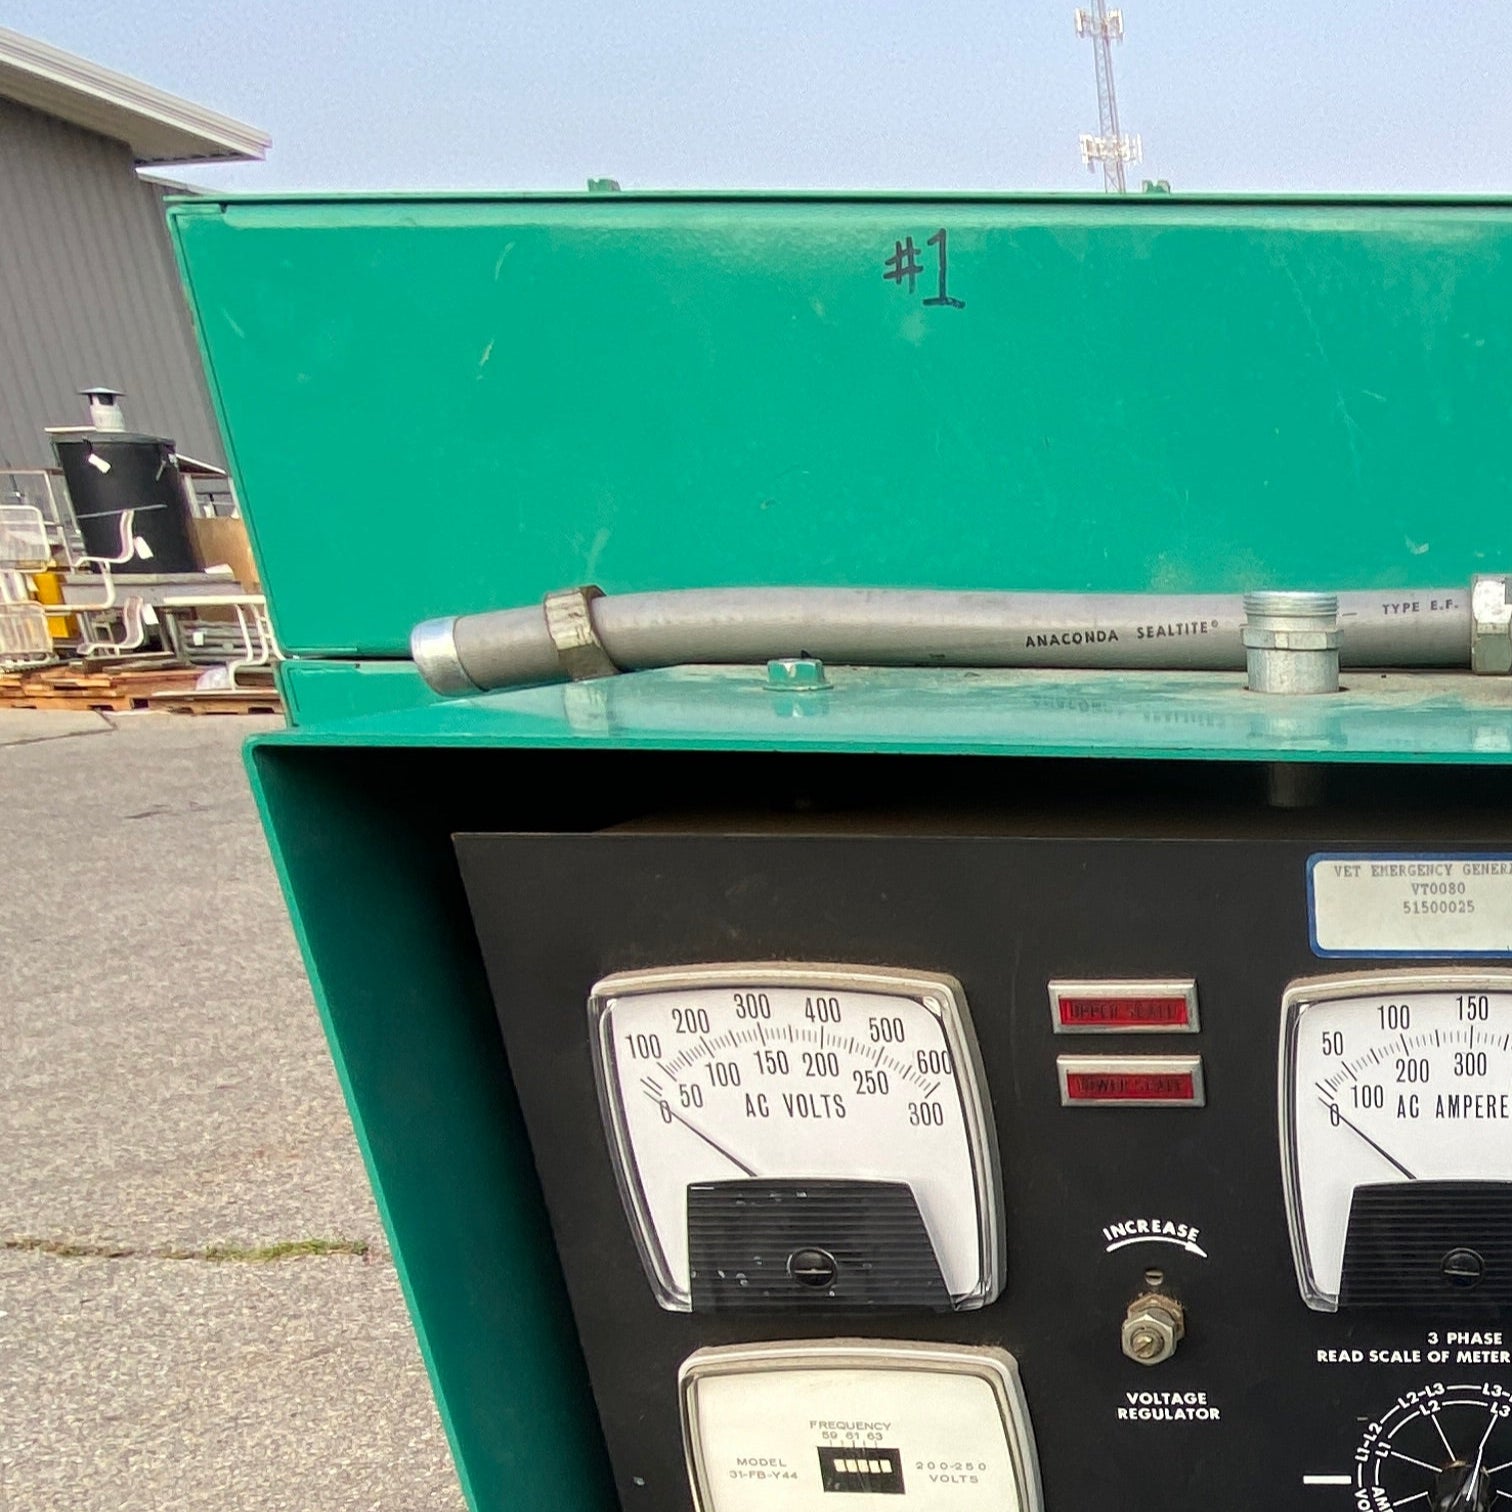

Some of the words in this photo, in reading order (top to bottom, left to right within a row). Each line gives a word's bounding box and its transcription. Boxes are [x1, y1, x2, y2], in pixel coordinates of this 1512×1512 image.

[882, 229, 966, 308] #1
[1382, 601, 1420, 615] TYPE
[1025, 629, 1119, 647] ANACONDA
[1334, 865, 1361, 878] VET
[1371, 864, 1453, 877] EMERGENCY
[1403, 900, 1475, 914] 51500025
[735, 993, 771, 1019] 300
[804, 997, 842, 1023] 400
[1377, 1004, 1410, 1029] 100
[1456, 995, 1489, 1021] 150
[671, 1008, 710, 1034] 200
[869, 1017, 905, 1043] 500
[625, 1033, 662, 1060] 100
[1322, 1031, 1344, 1056] 50
[705, 1061, 741, 1087] 100
[753, 1049, 789, 1075] 150
[802, 1052, 840, 1077] 200
[916, 1049, 952, 1075] 600
[1396, 1058, 1430, 1083] 200
[1454, 1052, 1487, 1077] 300
[853, 1069, 890, 1095] 250
[678, 1084, 704, 1109] 50
[745, 1093, 770, 1118] AC
[785, 1093, 847, 1119] VOLTS
[1350, 1084, 1384, 1109] 100
[1397, 1094, 1419, 1118] AC
[659, 1101, 673, 1124] 0
[908, 1102, 944, 1126] 300
[1329, 1103, 1341, 1127] 0
[1102, 1219, 1200, 1242] INCREASE
[1428, 1332, 1438, 1345] 3
[1447, 1332, 1502, 1345] PHASE
[1317, 1350, 1363, 1363] READ
[1369, 1350, 1421, 1363] SCALE
[1427, 1350, 1450, 1363] OF
[1456, 1351, 1511, 1364] METER
[1126, 1392, 1207, 1405] VOLTAGE
[1397, 1382, 1445, 1409] L2-L3
[1419, 1400, 1441, 1416] L2
[1118, 1408, 1221, 1421] REGULATOR
[1490, 1401, 1511, 1418] L3
[809, 1420, 892, 1431] FREQUENCY
[822, 1431, 838, 1440] 59
[867, 1431, 883, 1441] 63
[1354, 1422, 1383, 1462] L1-L2
[1375, 1441, 1392, 1458] L1
[737, 1457, 787, 1467] MODEL
[929, 1474, 979, 1484] VOLTS
